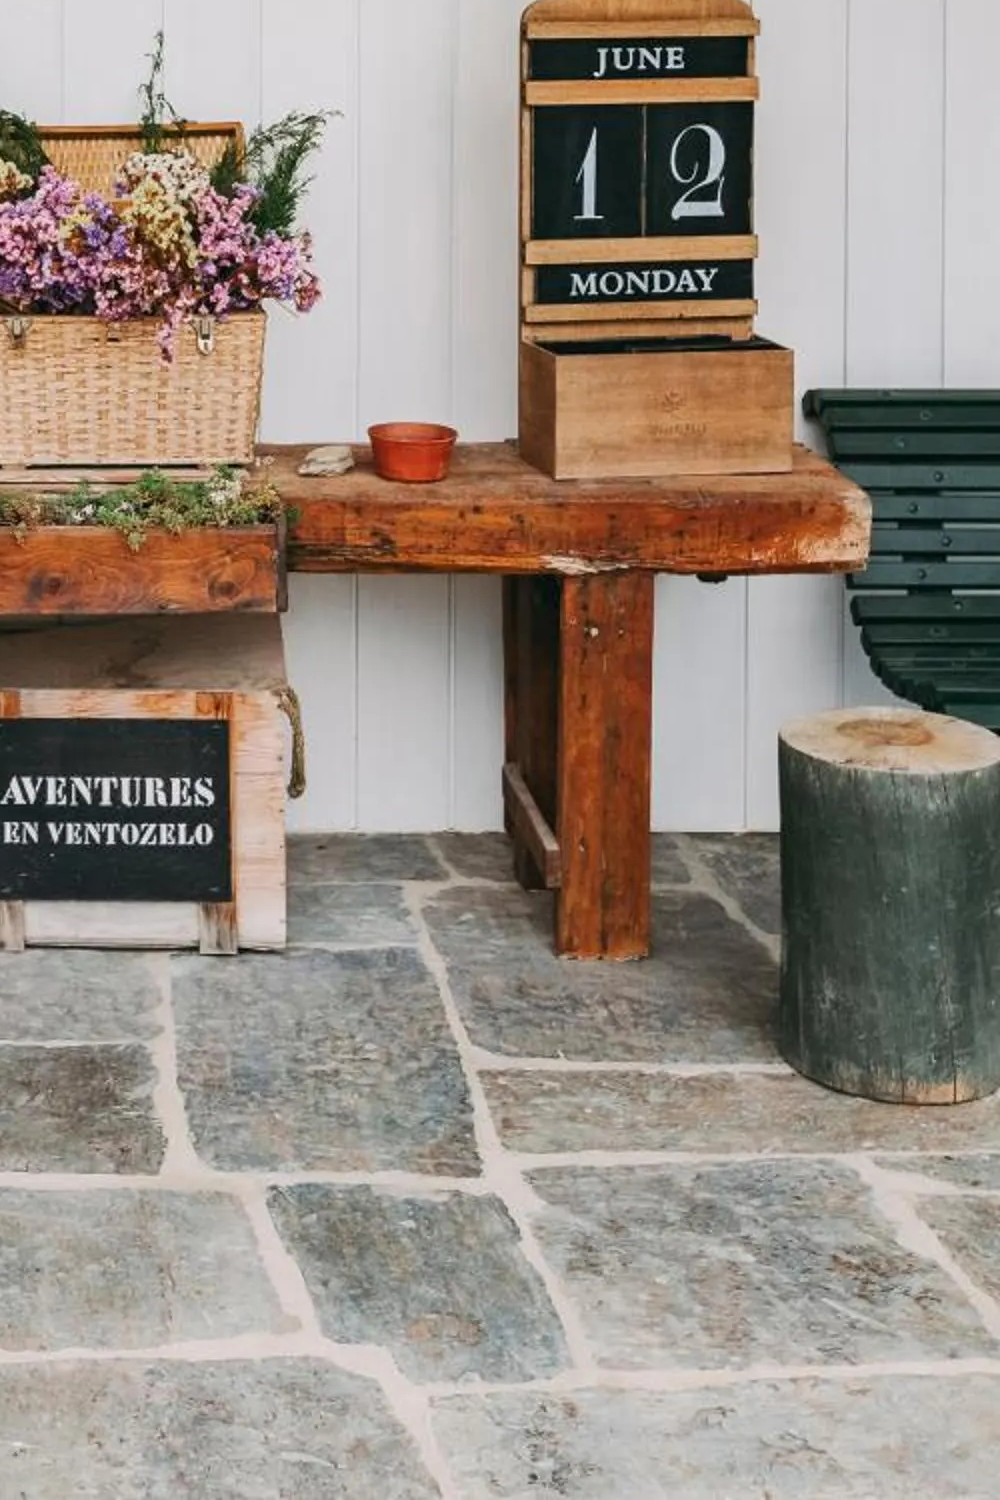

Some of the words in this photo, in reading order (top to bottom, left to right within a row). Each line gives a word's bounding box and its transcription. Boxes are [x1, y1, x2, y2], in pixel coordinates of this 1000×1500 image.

[593, 46, 686, 77] JUNE
[570, 267, 718, 297] MONDAY
[0, 775, 215, 807] AVENTURES
[3, 821, 39, 845] EN
[47, 822, 214, 846] VENTOZELO
